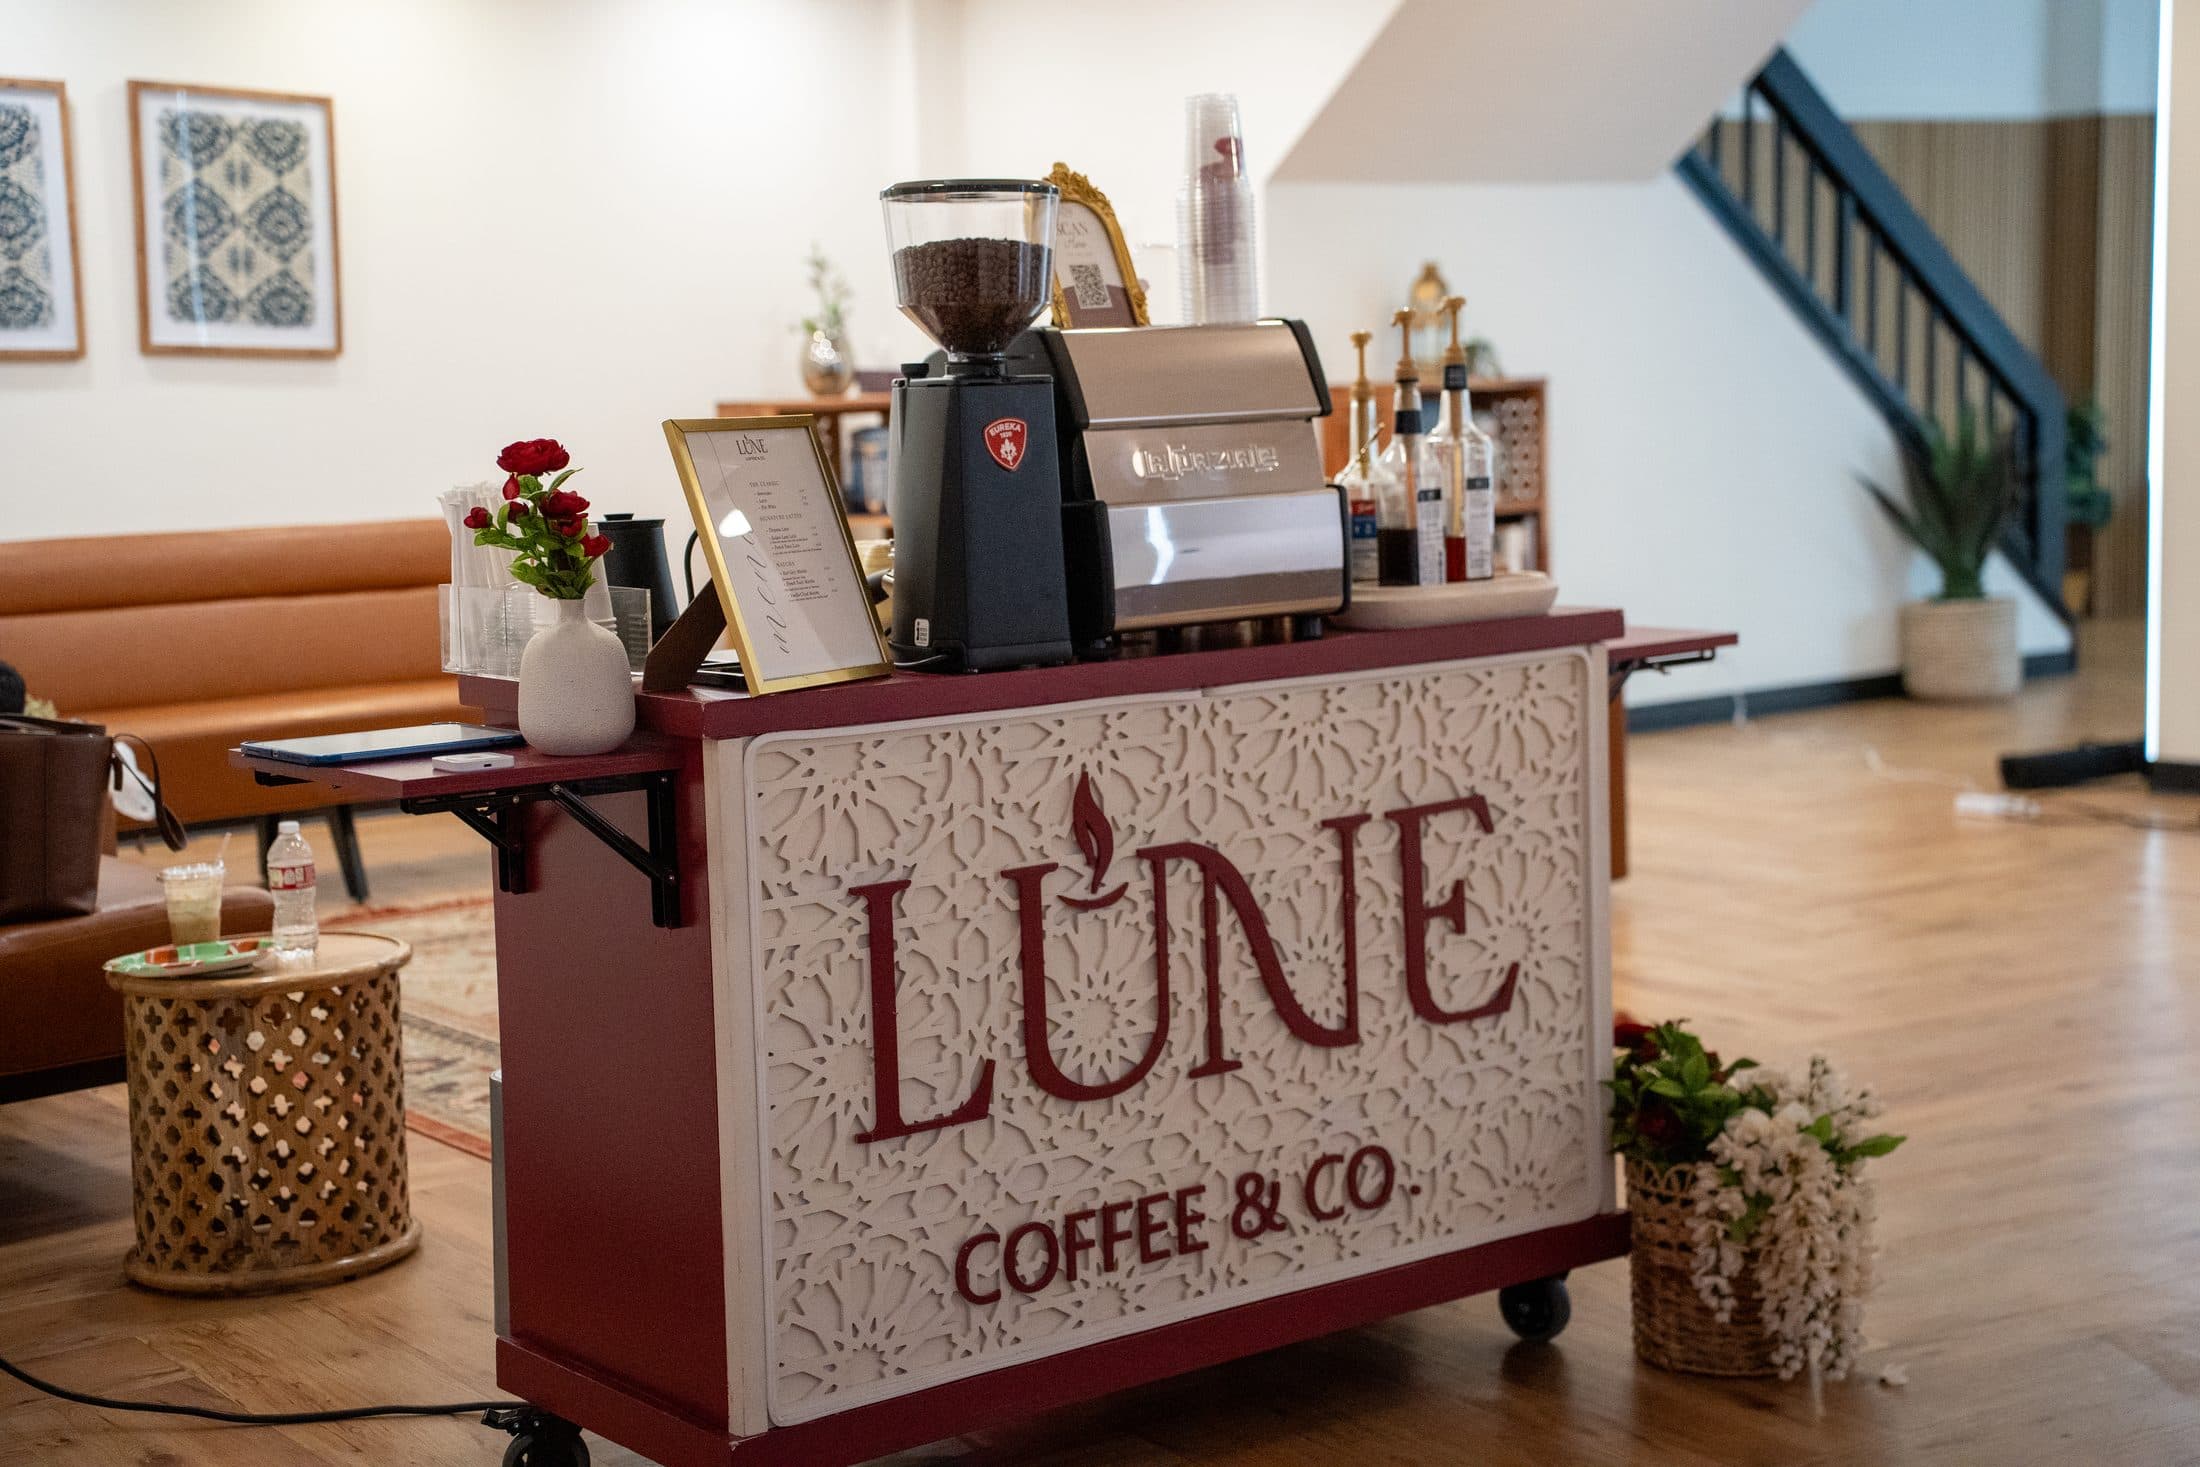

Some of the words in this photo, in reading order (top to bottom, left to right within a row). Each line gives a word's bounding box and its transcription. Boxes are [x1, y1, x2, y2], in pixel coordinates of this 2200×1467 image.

[988, 422, 1022, 437] EUREKA
[955, 1185, 1210, 1305] COFFEE
[1231, 1172, 1287, 1240] &
[1304, 1145, 1422, 1222] CO.
